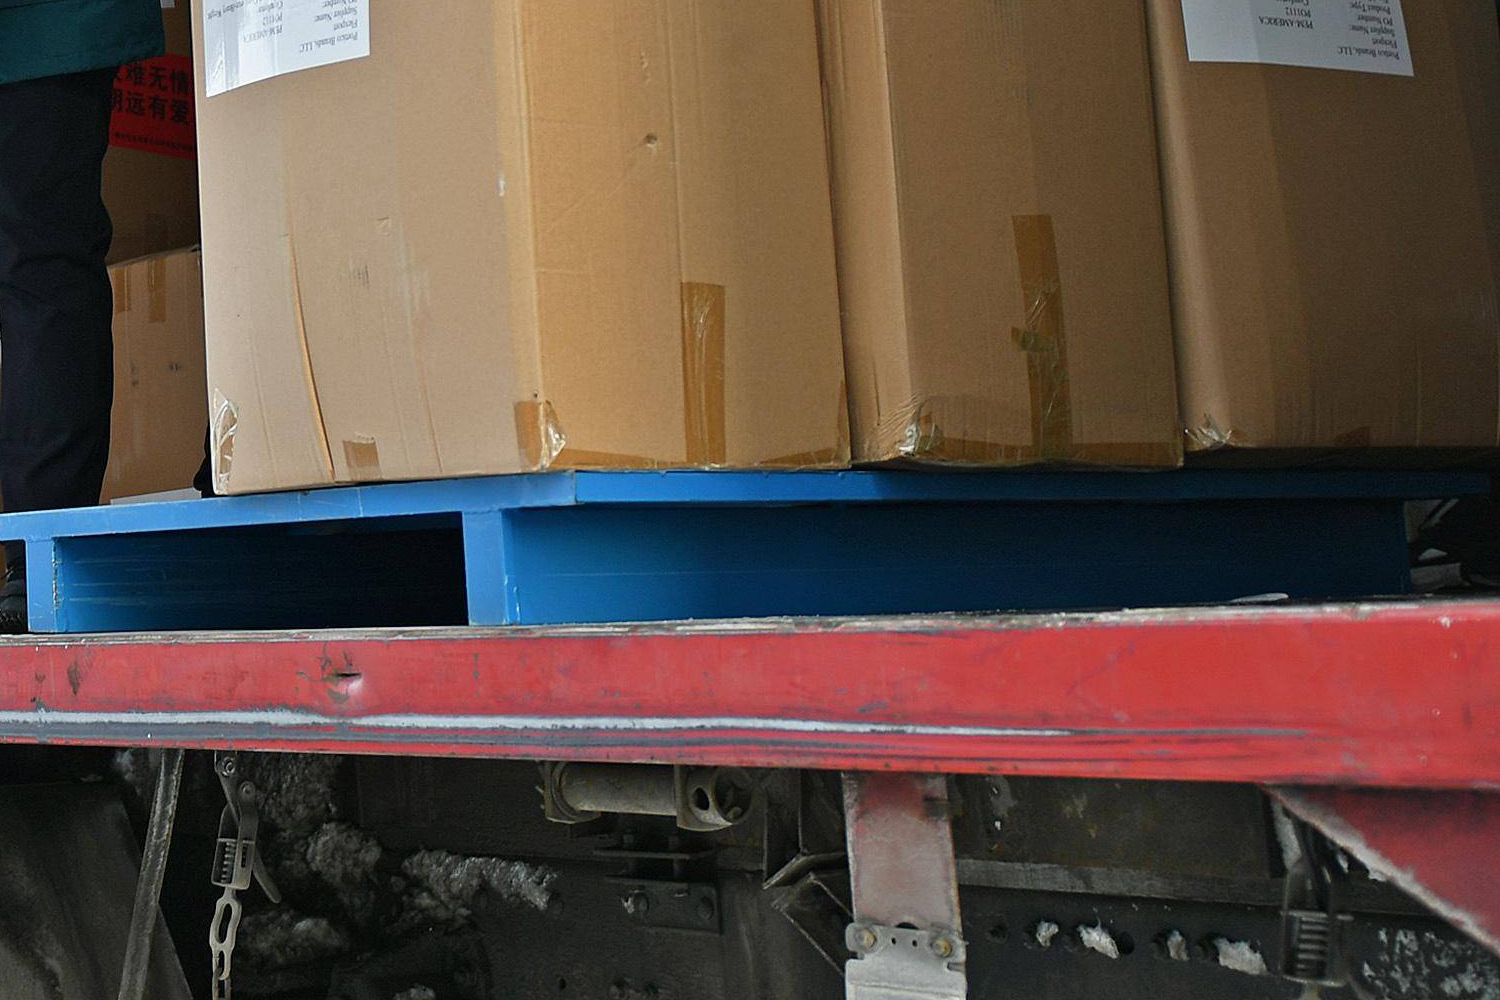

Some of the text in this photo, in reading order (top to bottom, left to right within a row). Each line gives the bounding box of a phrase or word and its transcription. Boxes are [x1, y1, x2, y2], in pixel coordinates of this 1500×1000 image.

[1338, 47, 1352, 55] LLC
[117, 60, 188, 96] 难无情
